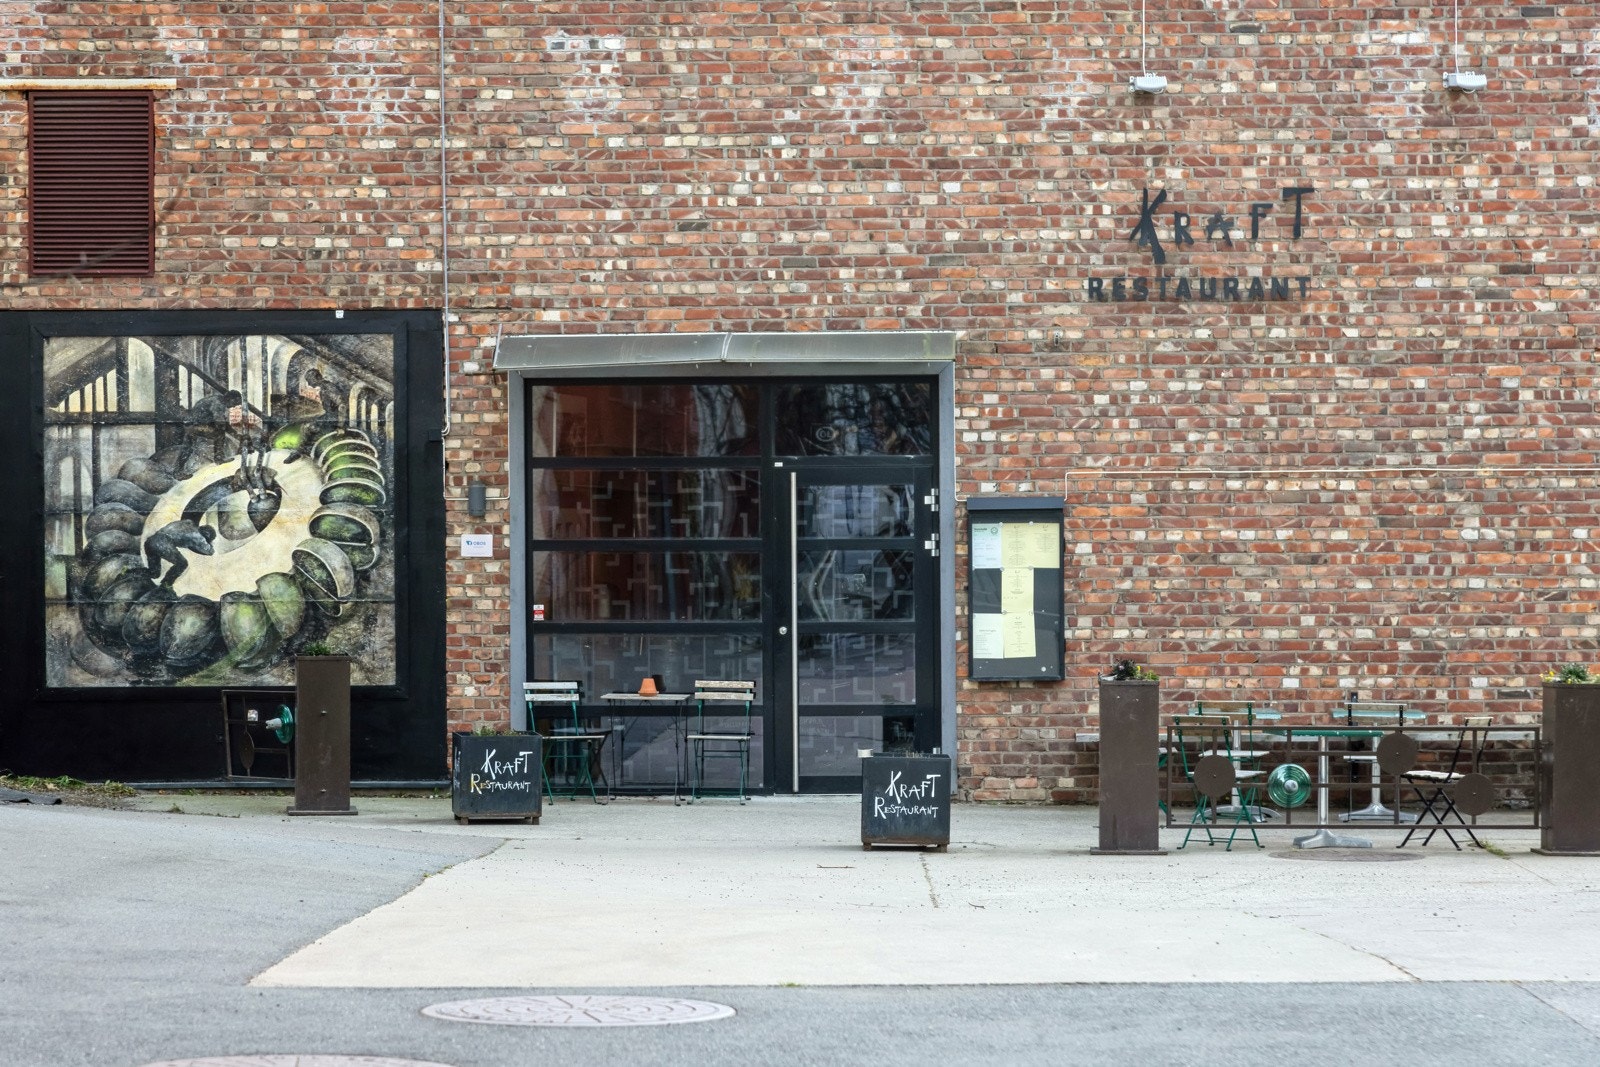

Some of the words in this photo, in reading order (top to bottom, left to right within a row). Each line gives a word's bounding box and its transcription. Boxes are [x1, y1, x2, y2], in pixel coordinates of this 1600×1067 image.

[1129, 187, 1315, 265] KRAFT
[1088, 276, 1311, 301] RESTAURANT
[480, 748, 533, 780] KRAFT
[470, 773, 531, 794] RESTAURANT
[885, 770, 941, 804] KRAFT
[874, 796, 939, 819] RESTAURANT
